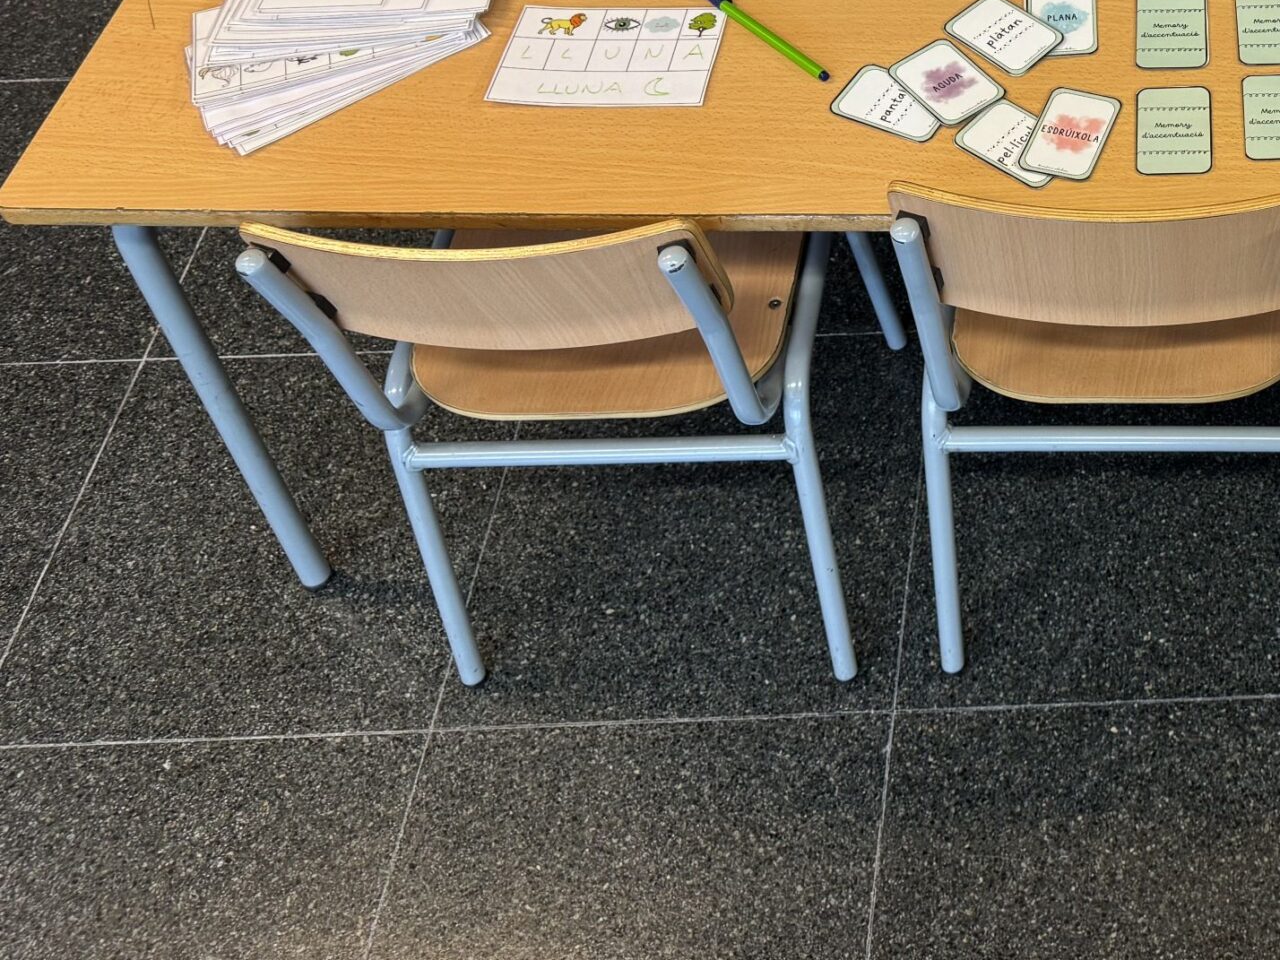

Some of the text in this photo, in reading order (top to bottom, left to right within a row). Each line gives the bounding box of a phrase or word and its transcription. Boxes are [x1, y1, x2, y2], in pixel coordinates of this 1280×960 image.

[1046, 12, 1078, 22] PLANA
[986, 18, 1024, 50] plàtan
[1152, 22, 1188, 30] Memory
[520, 45, 532, 60] L
[604, 45, 622, 60] U
[645, 44, 664, 60] N
[683, 44, 704, 60] A
[537, 80, 623, 96] LLUNA
[932, 73, 963, 93] AGUDA
[880, 90, 907, 124] panta
[1041, 124, 1100, 143] ESDRÚIXOLA
[1154, 122, 1192, 130] Memory
